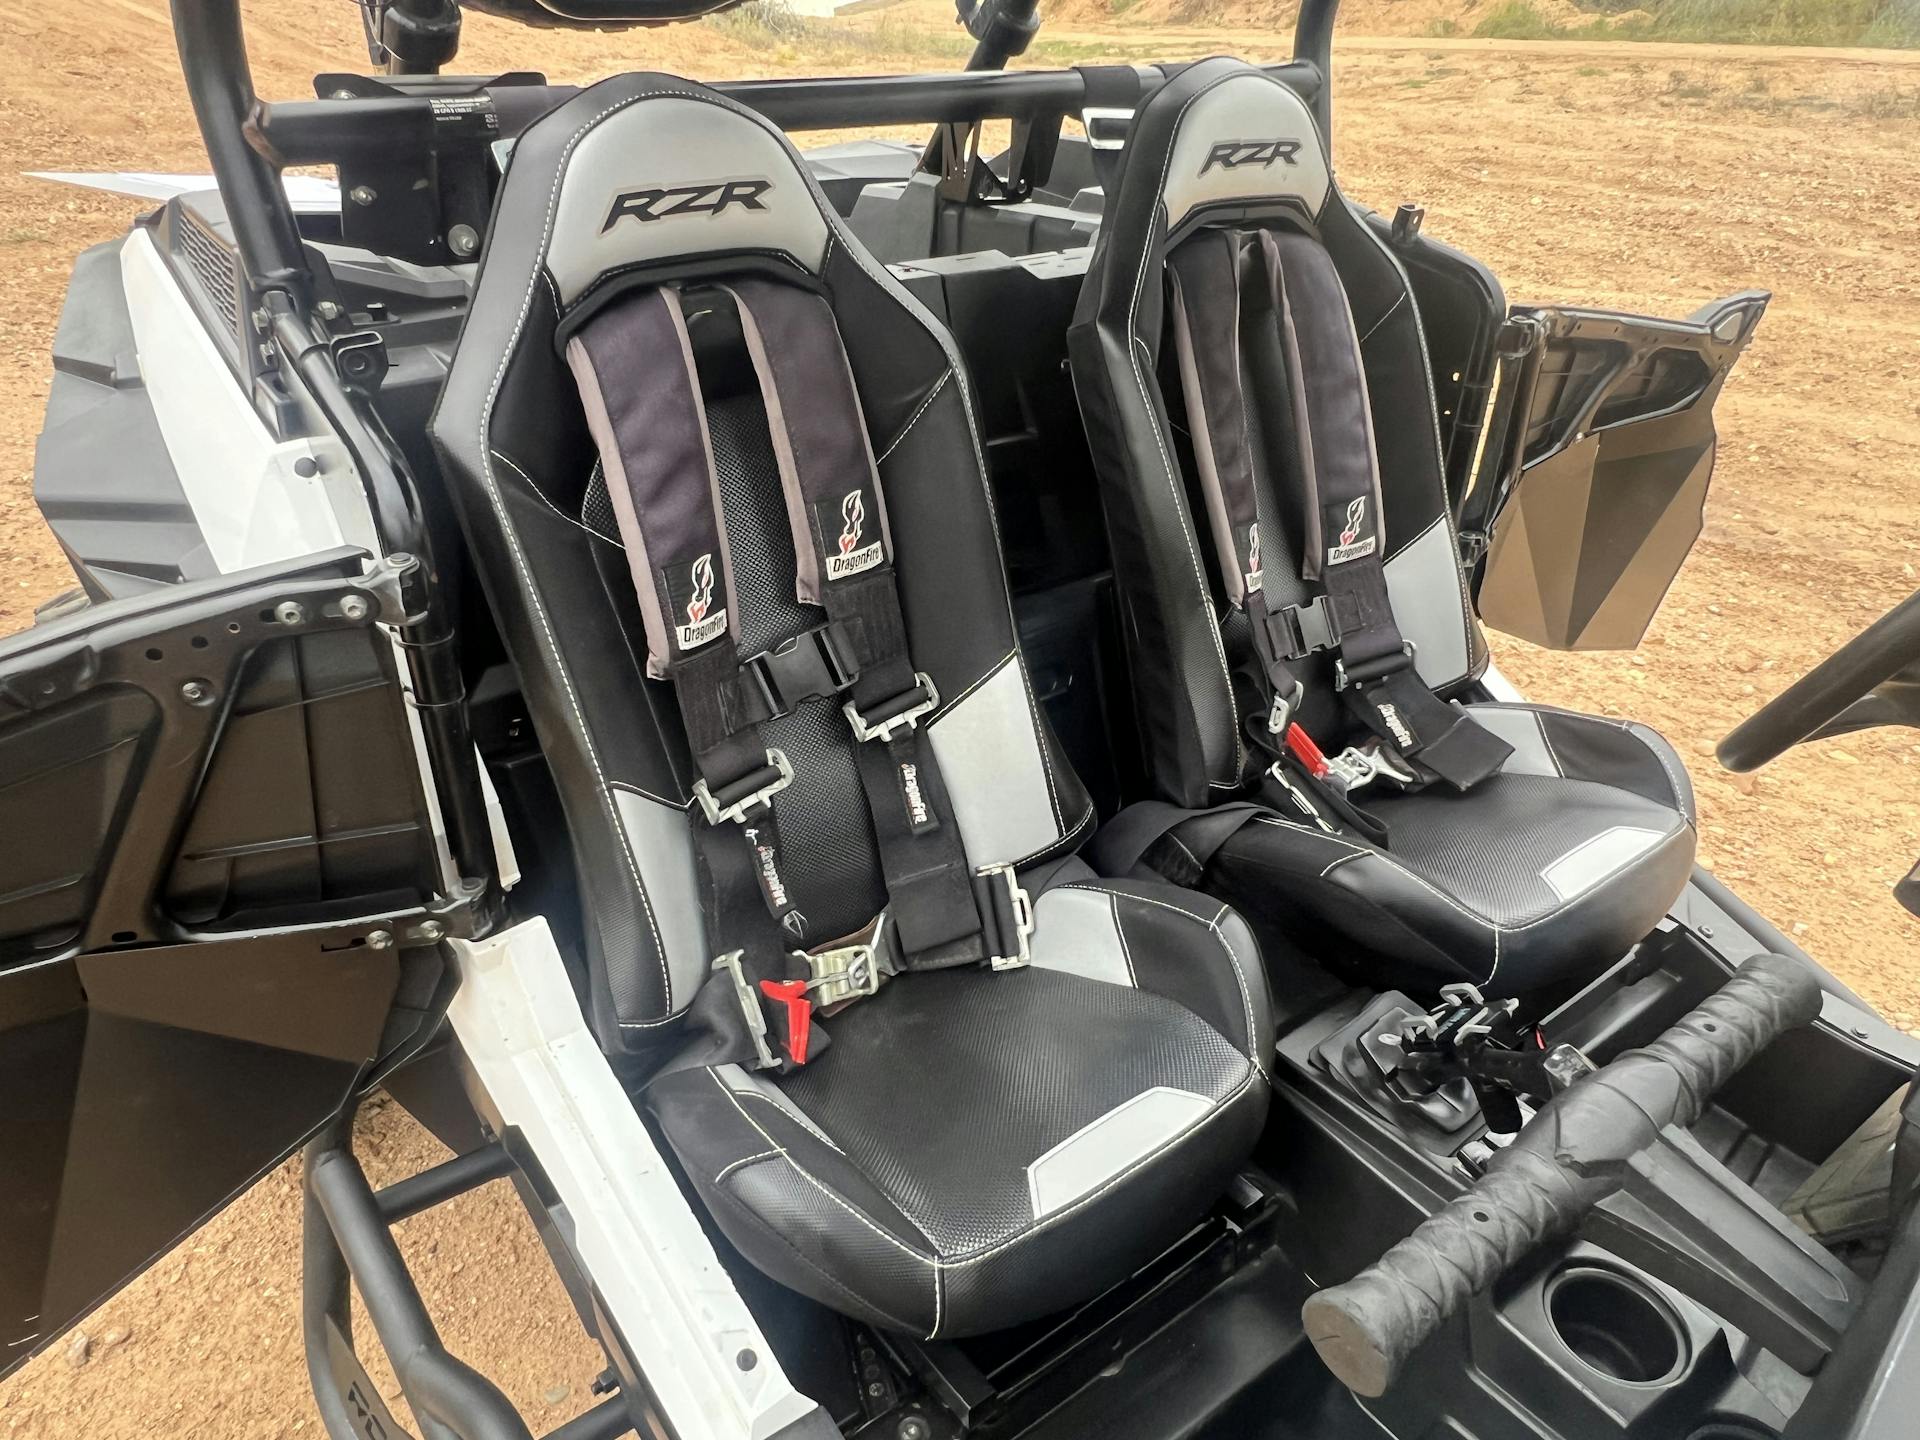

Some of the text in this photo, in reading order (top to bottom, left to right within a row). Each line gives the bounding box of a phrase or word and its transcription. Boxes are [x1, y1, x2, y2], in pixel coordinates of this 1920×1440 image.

[1199, 141, 1302, 176] RZR
[600, 180, 773, 234] RZR
[833, 547, 879, 572] DragonFire
